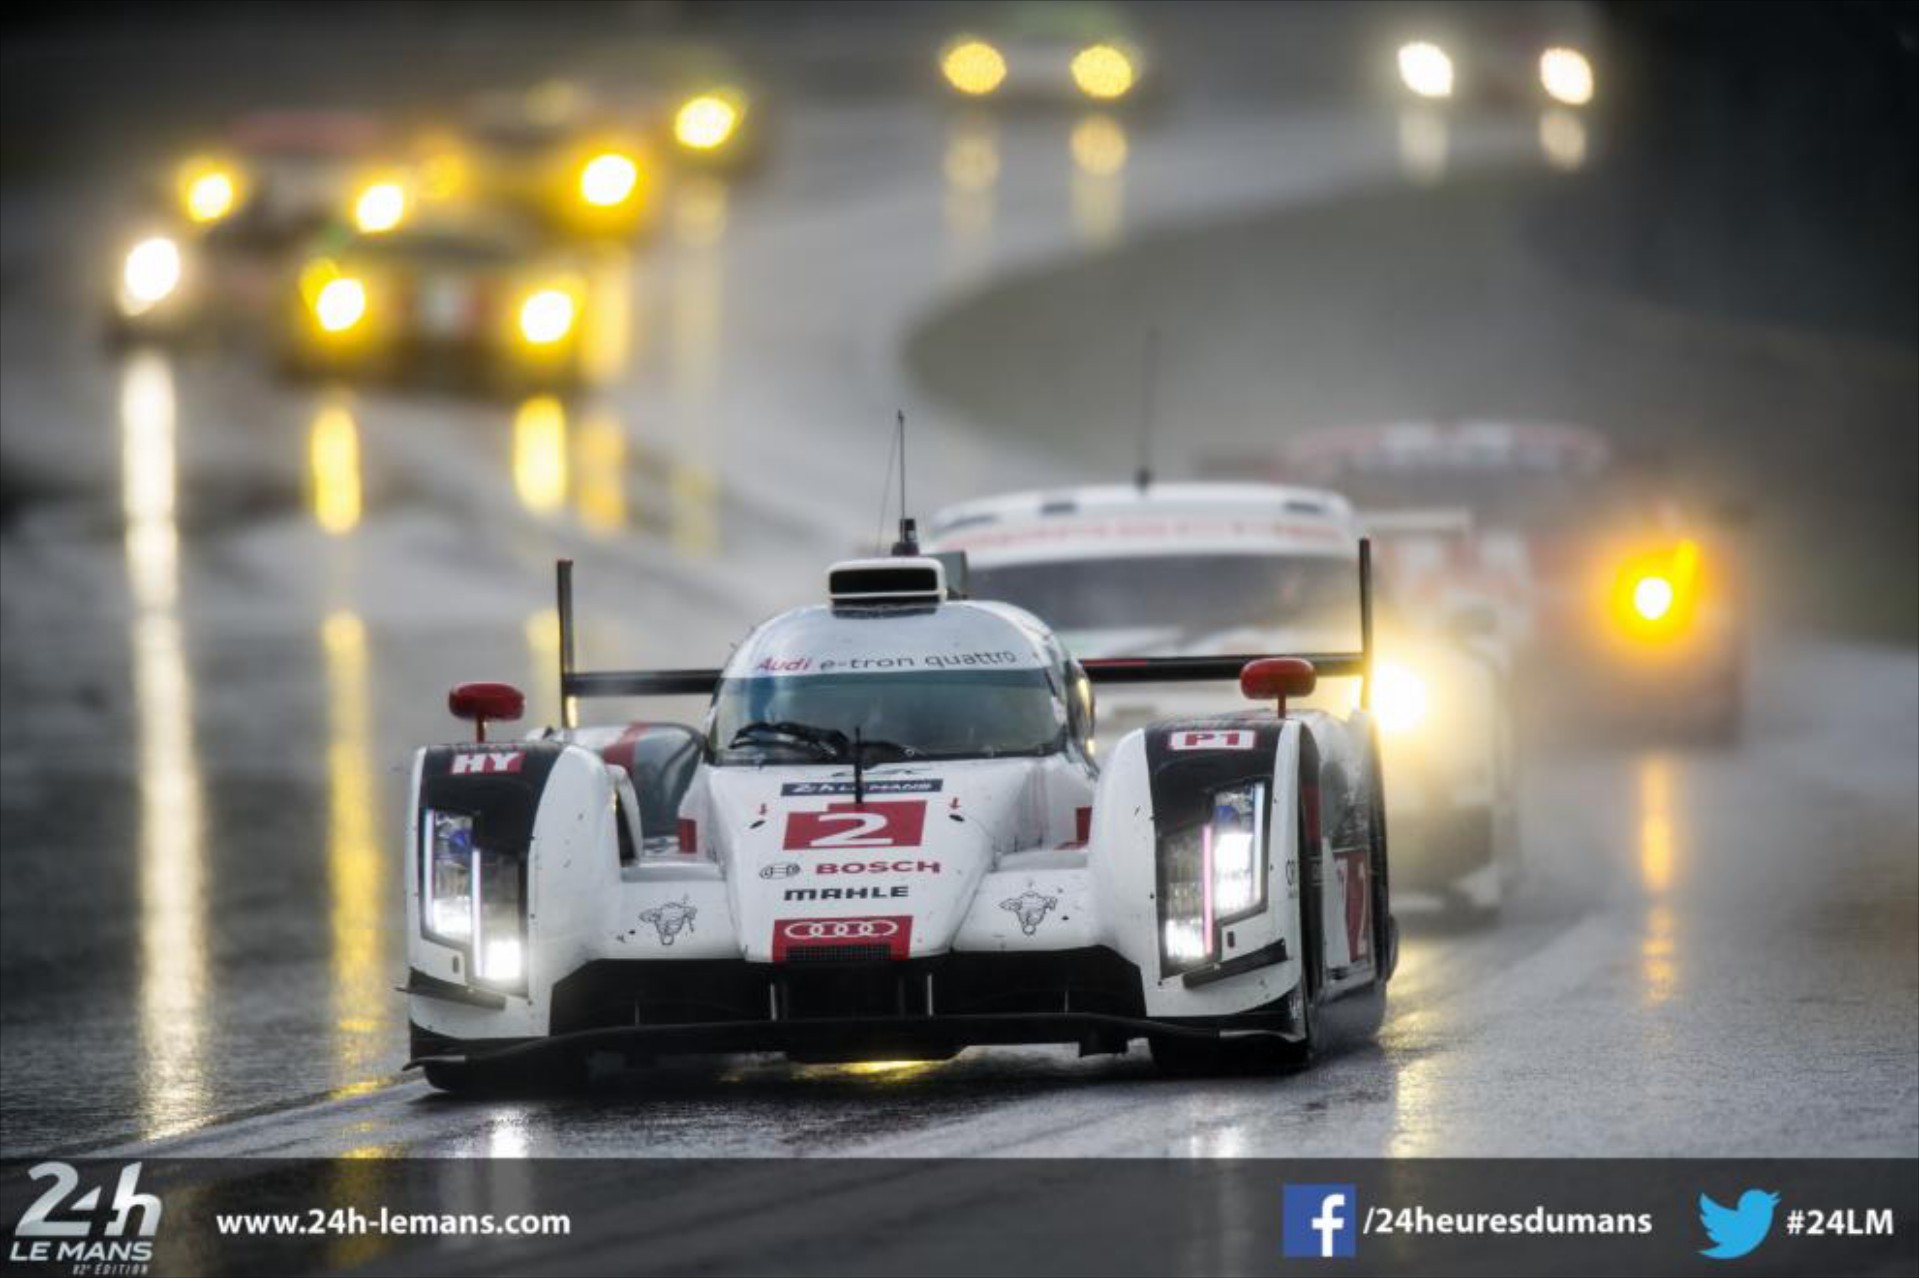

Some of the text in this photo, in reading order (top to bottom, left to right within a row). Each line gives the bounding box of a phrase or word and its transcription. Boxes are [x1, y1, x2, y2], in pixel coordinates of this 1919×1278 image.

[756, 651, 1017, 672] Audi e-tron quattro
[1184, 732, 1240, 746] P1
[452, 752, 520, 774] HY
[810, 812, 894, 847] 2
[815, 861, 941, 875] BOSCH
[784, 886, 909, 901] MAHLE
